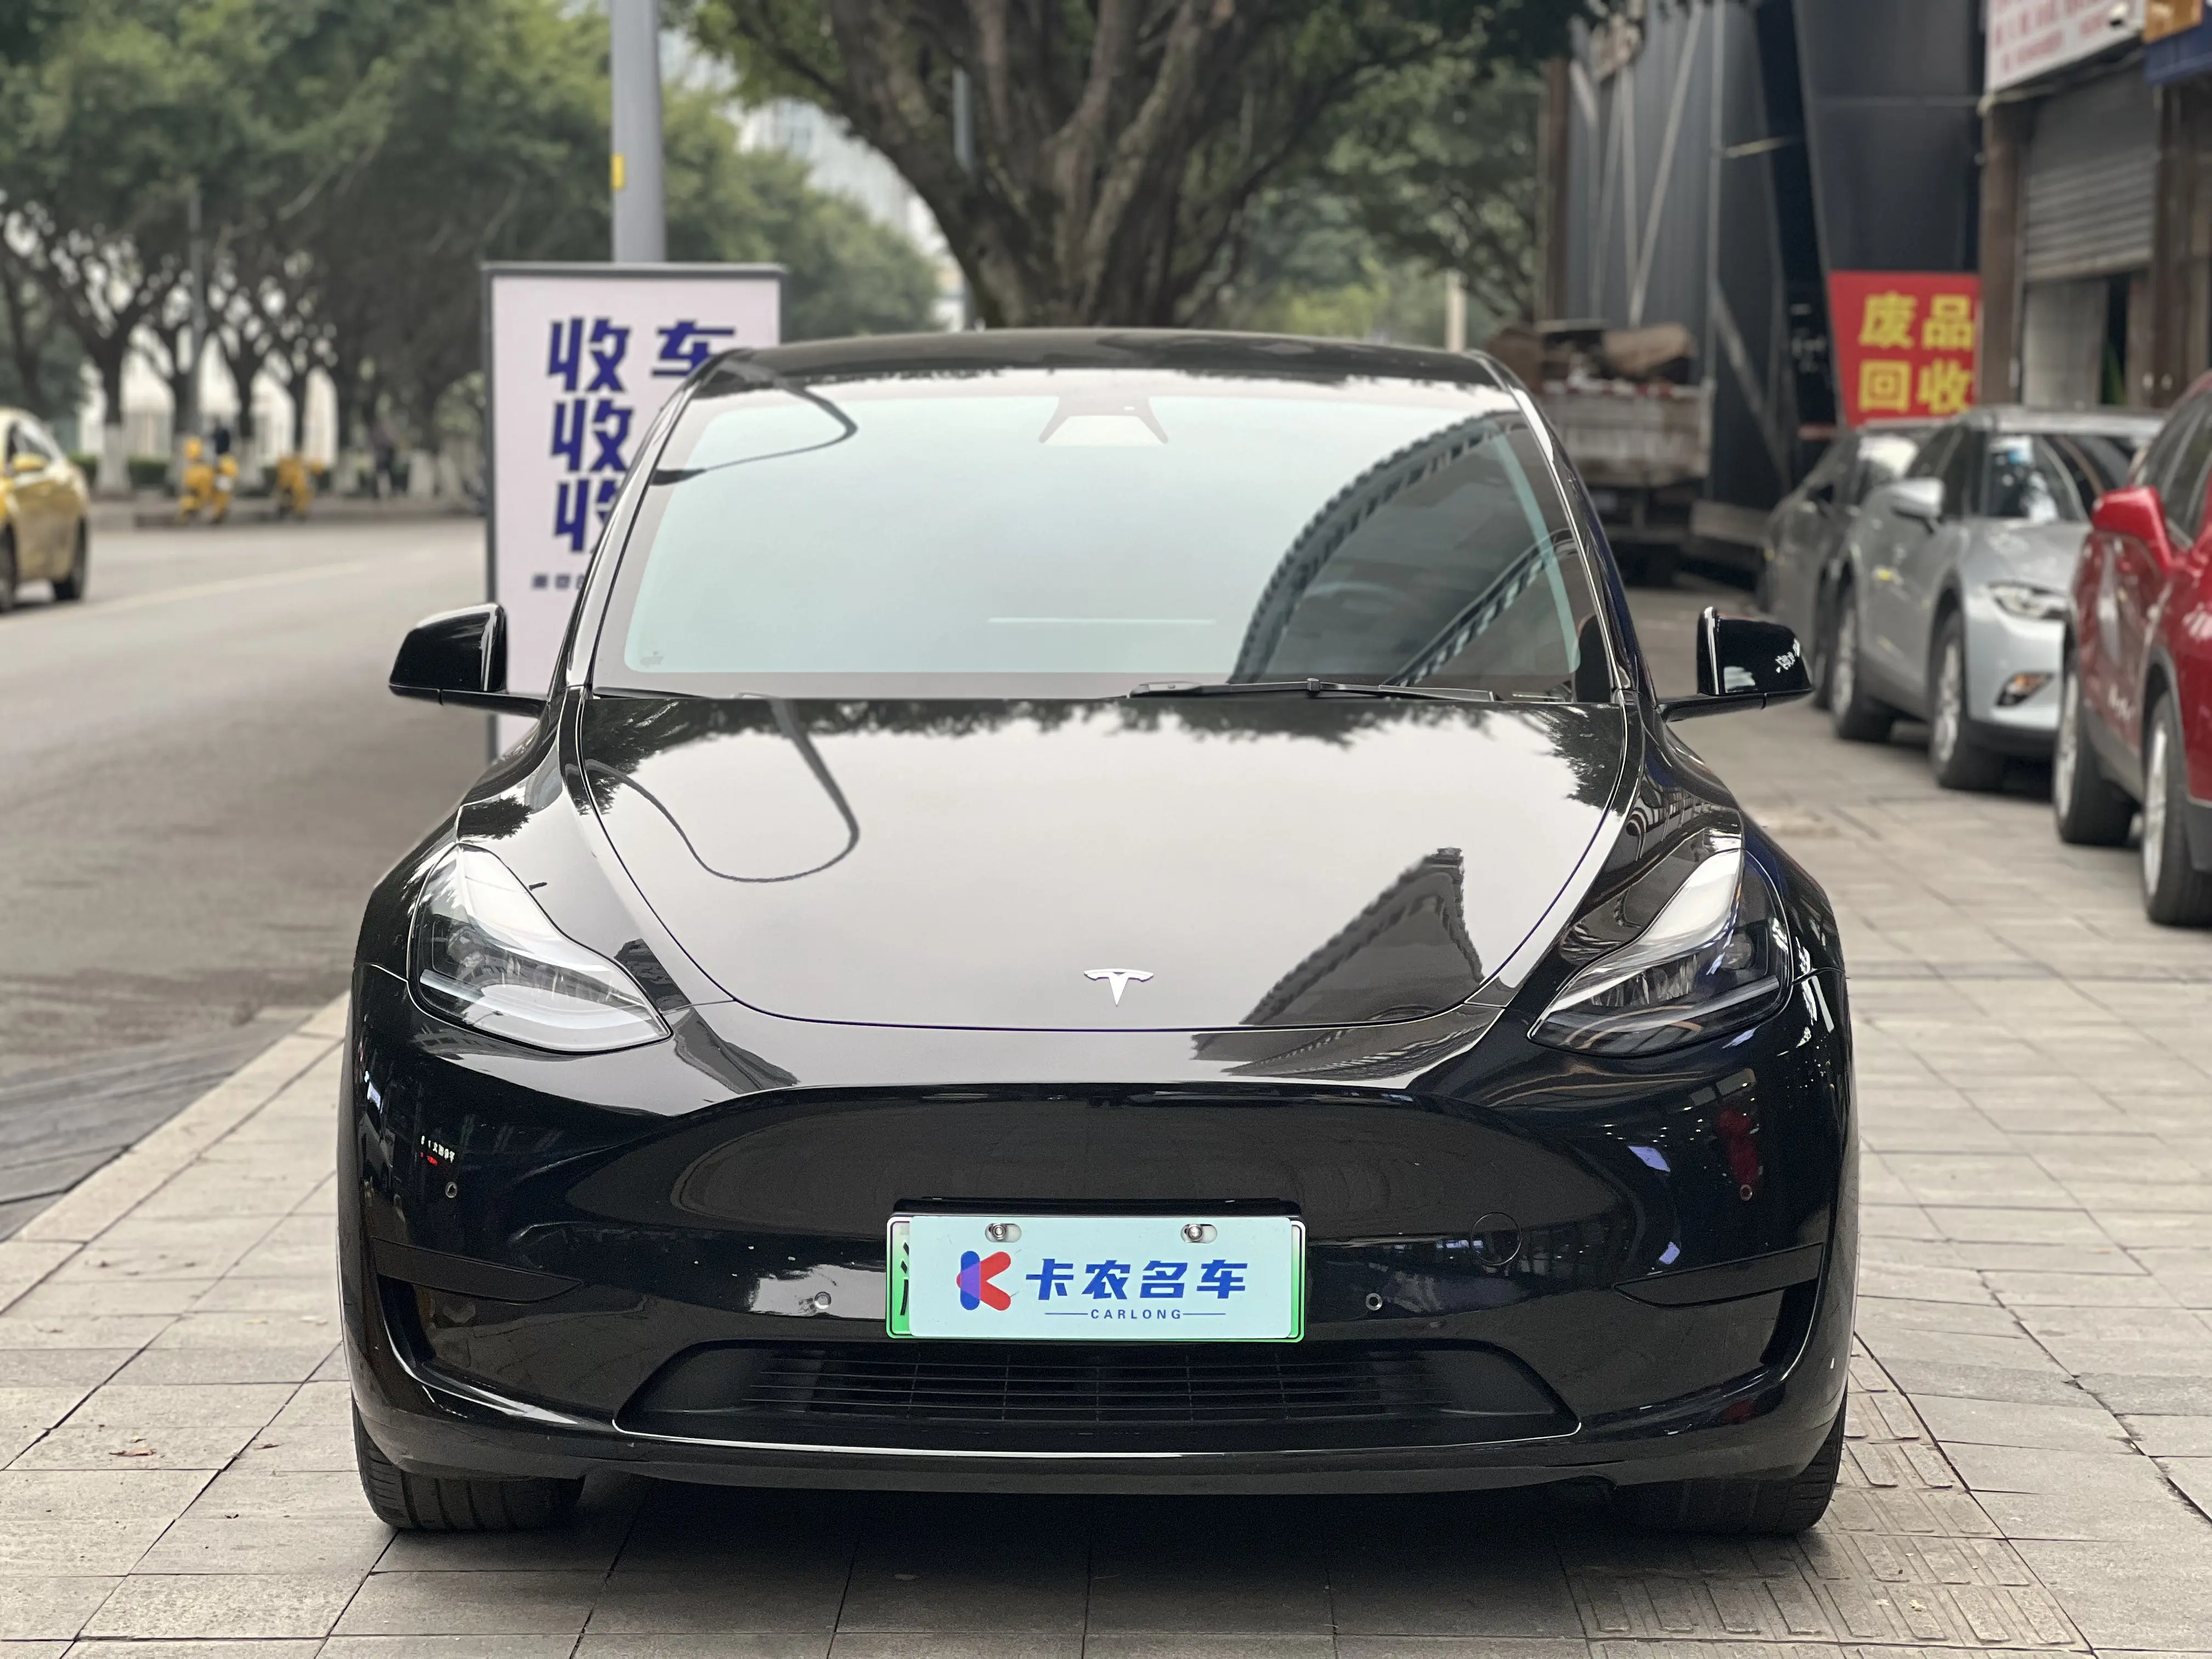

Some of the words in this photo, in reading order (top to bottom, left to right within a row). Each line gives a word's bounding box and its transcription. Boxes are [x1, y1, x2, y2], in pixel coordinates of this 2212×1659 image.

[1858, 290, 1973, 350] 废品
[547, 317, 736, 392] 收车
[1858, 358, 1972, 415] 回收
[1025, 1258, 1248, 1300] 卡农名车
[1091, 1308, 1182, 1319] CARLONG
